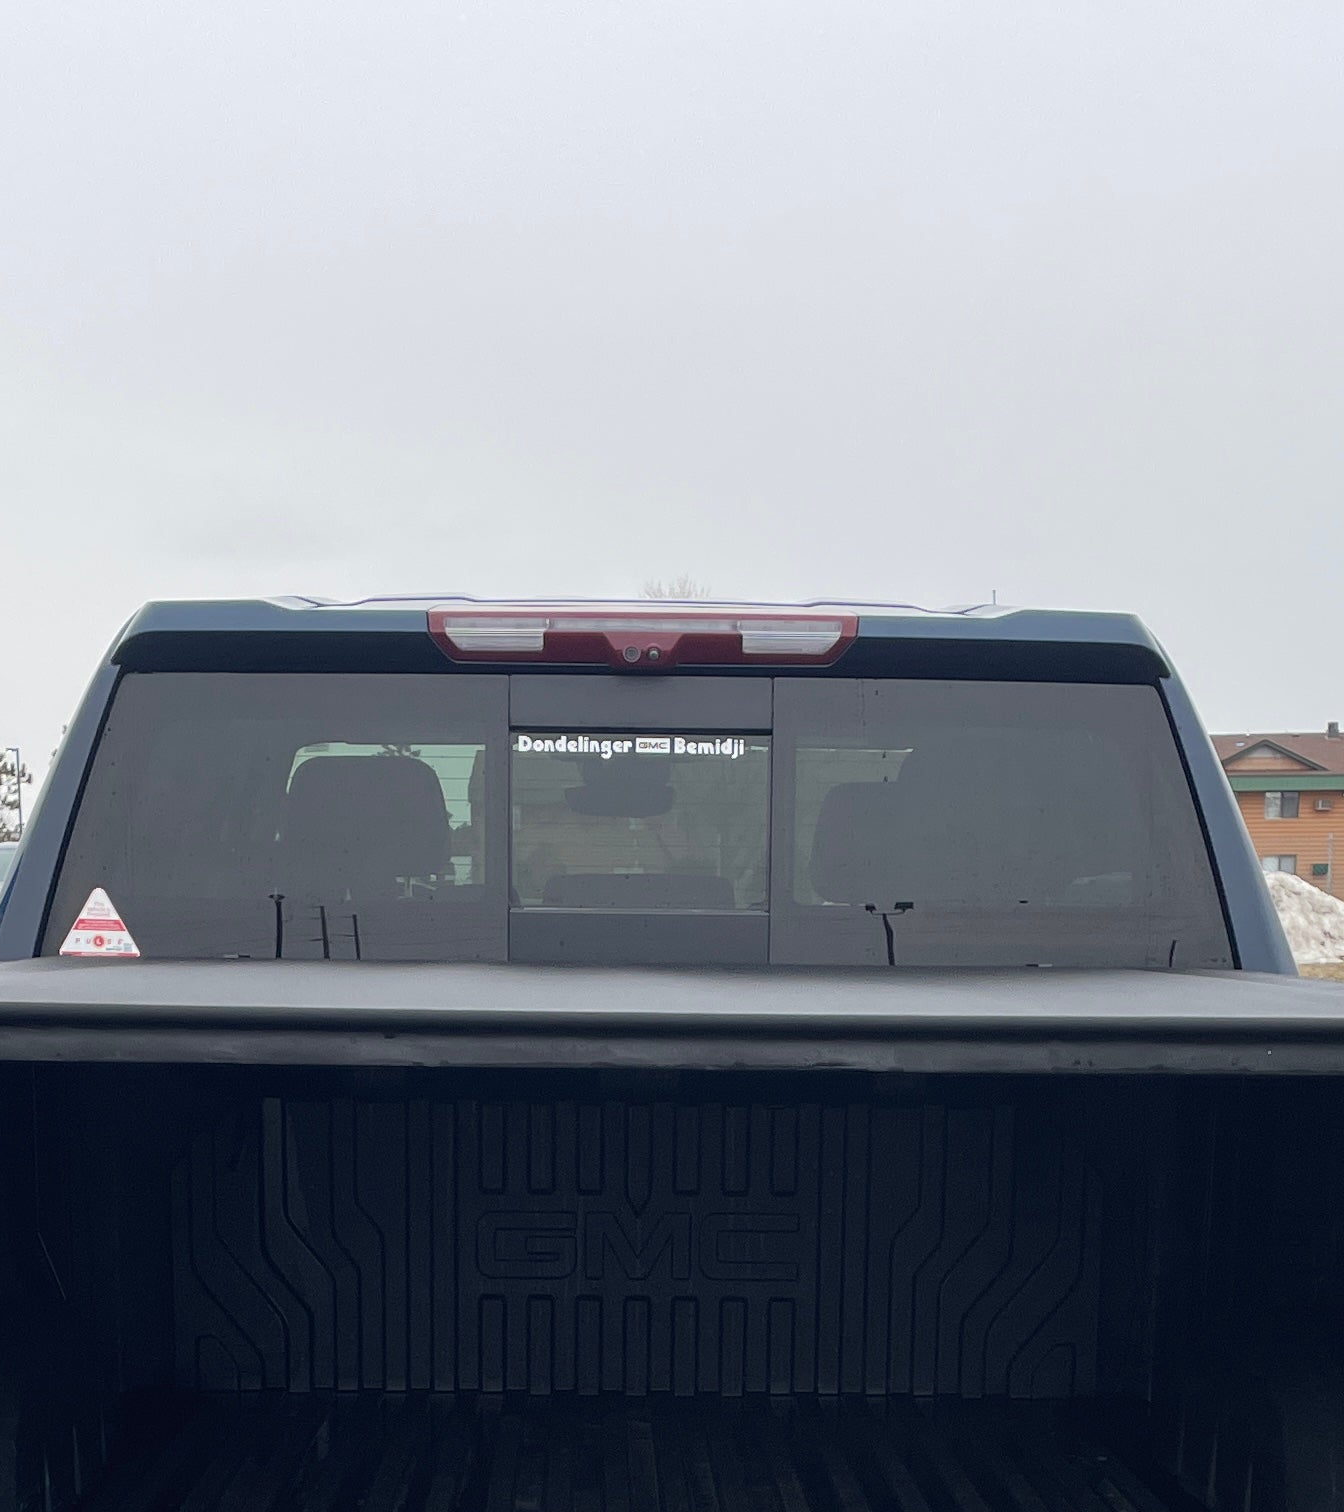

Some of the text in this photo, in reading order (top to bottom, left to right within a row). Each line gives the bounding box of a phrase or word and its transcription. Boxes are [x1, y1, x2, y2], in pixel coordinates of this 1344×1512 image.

[518, 735, 745, 759] Dondelinger GMC Bemidji
[475, 1211, 800, 1281] GMC
